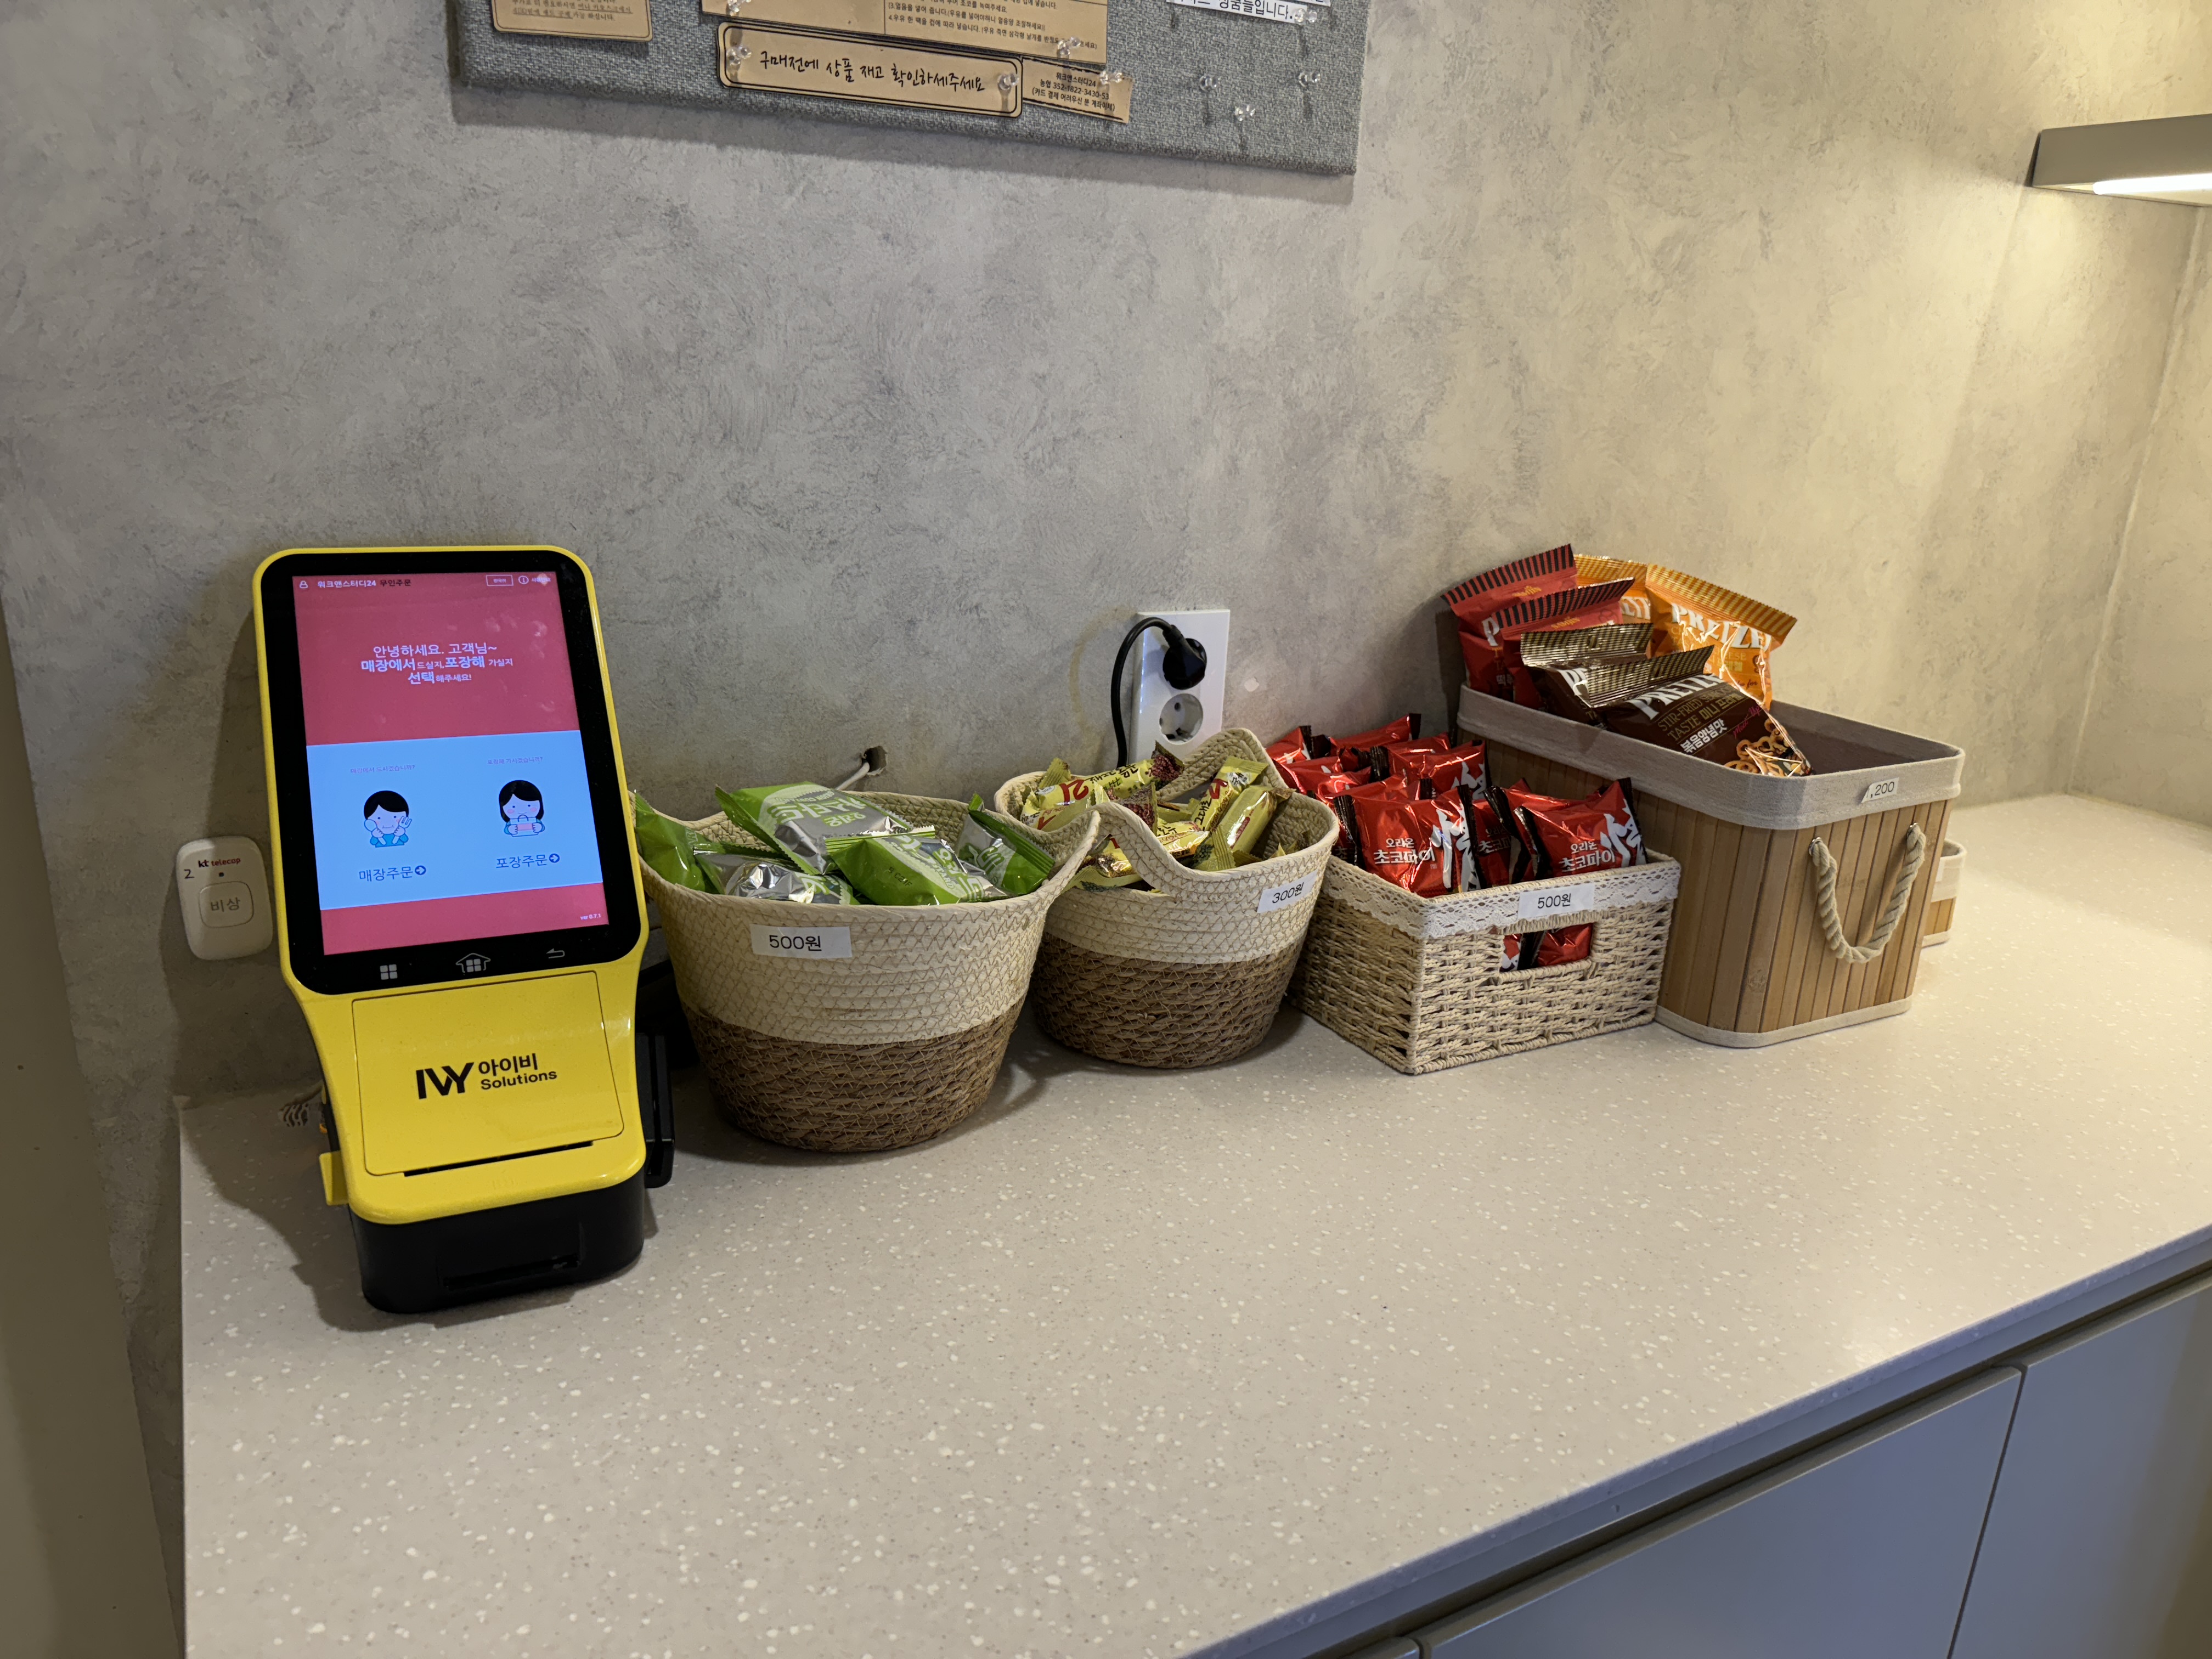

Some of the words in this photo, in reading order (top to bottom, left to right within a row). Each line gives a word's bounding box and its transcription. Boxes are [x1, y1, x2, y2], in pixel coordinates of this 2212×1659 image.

[760, 50, 819, 72] 구매전에
[826, 58, 854, 83] 상품
[860, 65, 884, 79] 재고
[1032, 87, 1046, 97] (카드
[1040, 78, 1051, 88] 농협
[1053, 82, 1109, 100] 352-1822-3430-53
[318, 579, 377, 589] 워크앤스터디24
[380, 579, 411, 587] 무인주문
[373, 644, 444, 658] 안녕하세요.
[448, 642, 497, 654] 고객님~
[361, 658, 416, 673] 매장에서
[488, 658, 514, 667] 가실지
[408, 671, 435, 685] 선택
[1658, 699, 1702, 732] STIR-FRIED
[1668, 715, 1702, 741] TASTE
[1699, 706, 1720, 720] 미니
[1680, 718, 1728, 754] 볶음양념맛
[824, 811, 866, 827] 오리온
[1386, 837, 1415, 849] 오리온
[1570, 840, 1598, 855] 오리온
[198, 859, 210, 868] kt
[211, 857, 241, 867] telecop
[496, 854, 548, 869] 포장주문
[1374, 847, 1436, 865] 초코파이
[1558, 850, 1616, 873] 초코파이
[359, 866, 413, 882] 매장주문
[1272, 882, 1305, 904] 300원
[1537, 893, 1571, 909] 500원
[210, 897, 241, 912] 비상
[769, 934, 822, 951] 500원
[478, 1053, 538, 1076] 아이비
[481, 1070, 557, 1090] Solutions
